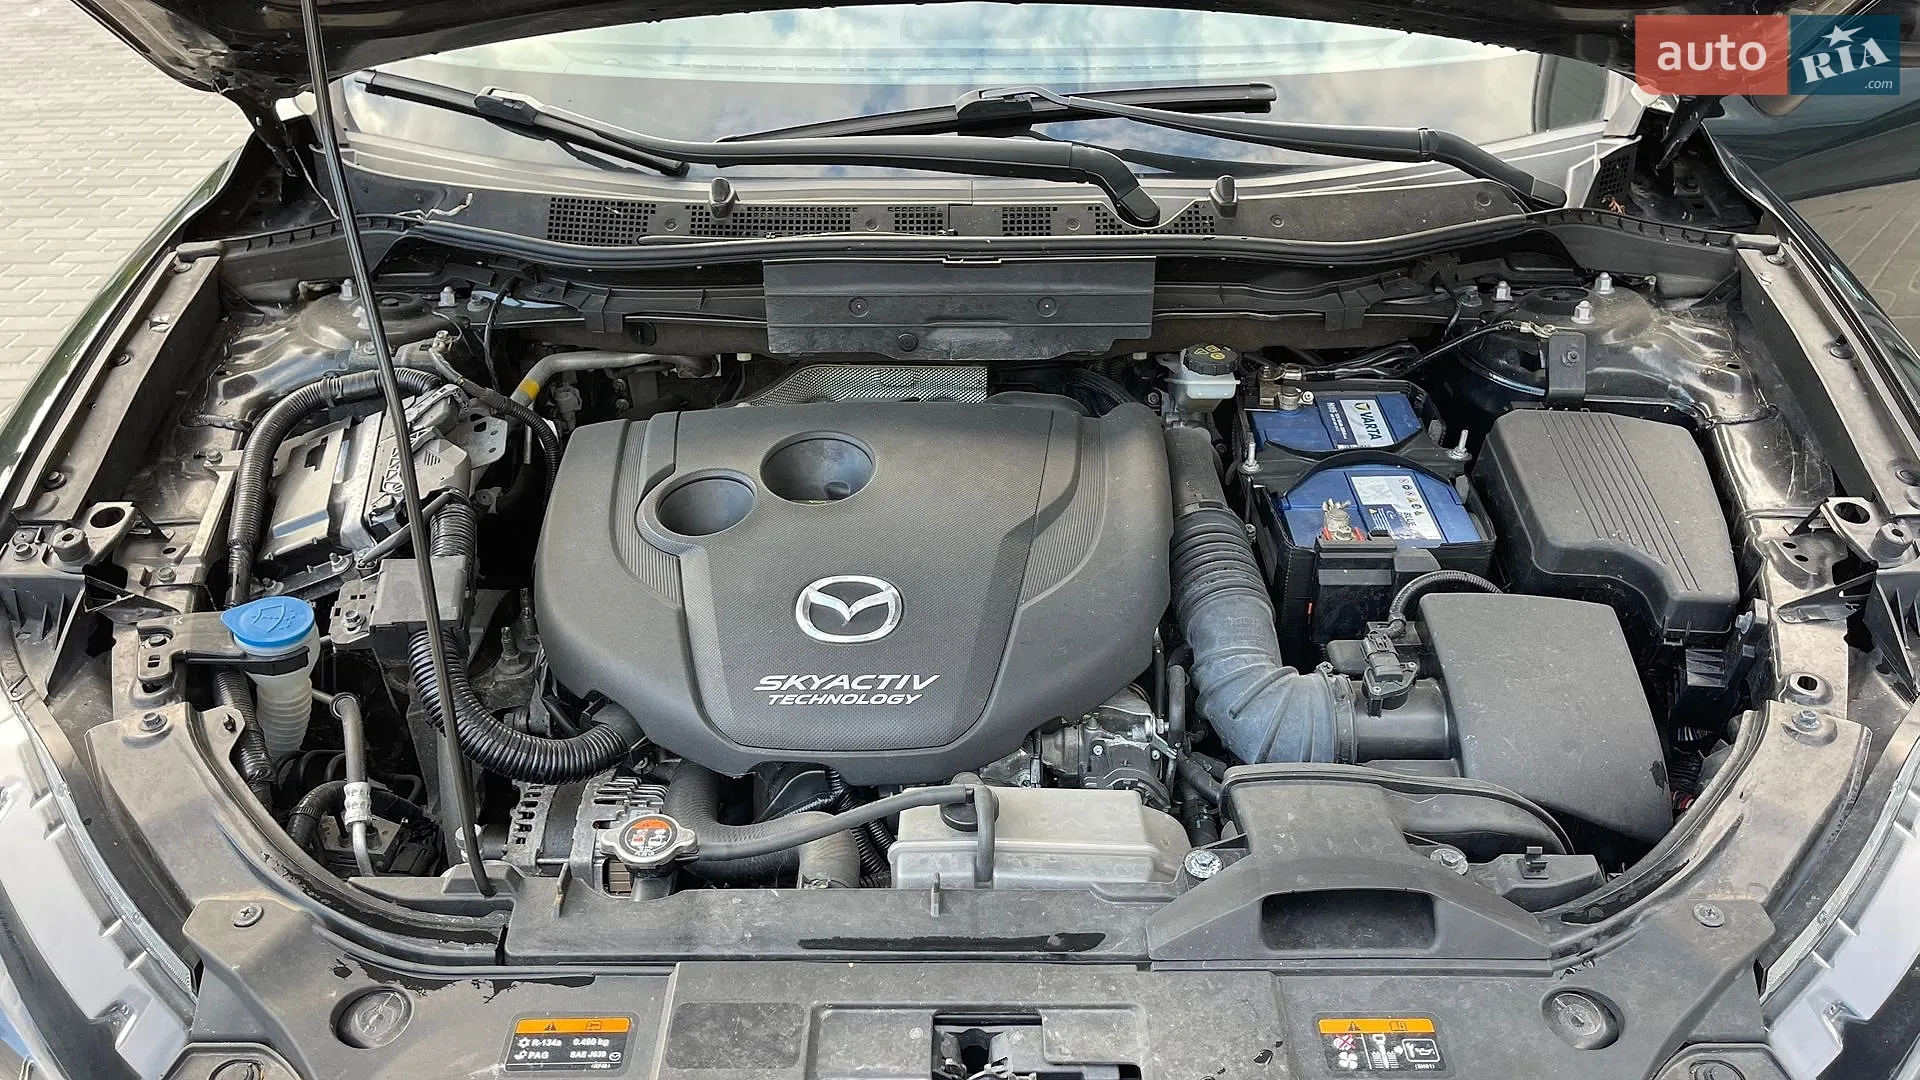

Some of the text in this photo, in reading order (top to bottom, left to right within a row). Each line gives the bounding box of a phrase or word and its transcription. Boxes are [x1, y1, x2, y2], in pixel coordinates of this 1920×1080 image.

[1360, 411, 1382, 440] VARTA
[753, 674, 941, 691] SKYACTIV
[768, 693, 923, 706] TECHNOLOGY
[597, 1038, 610, 1047] kg
[527, 1051, 549, 1060] PAG
